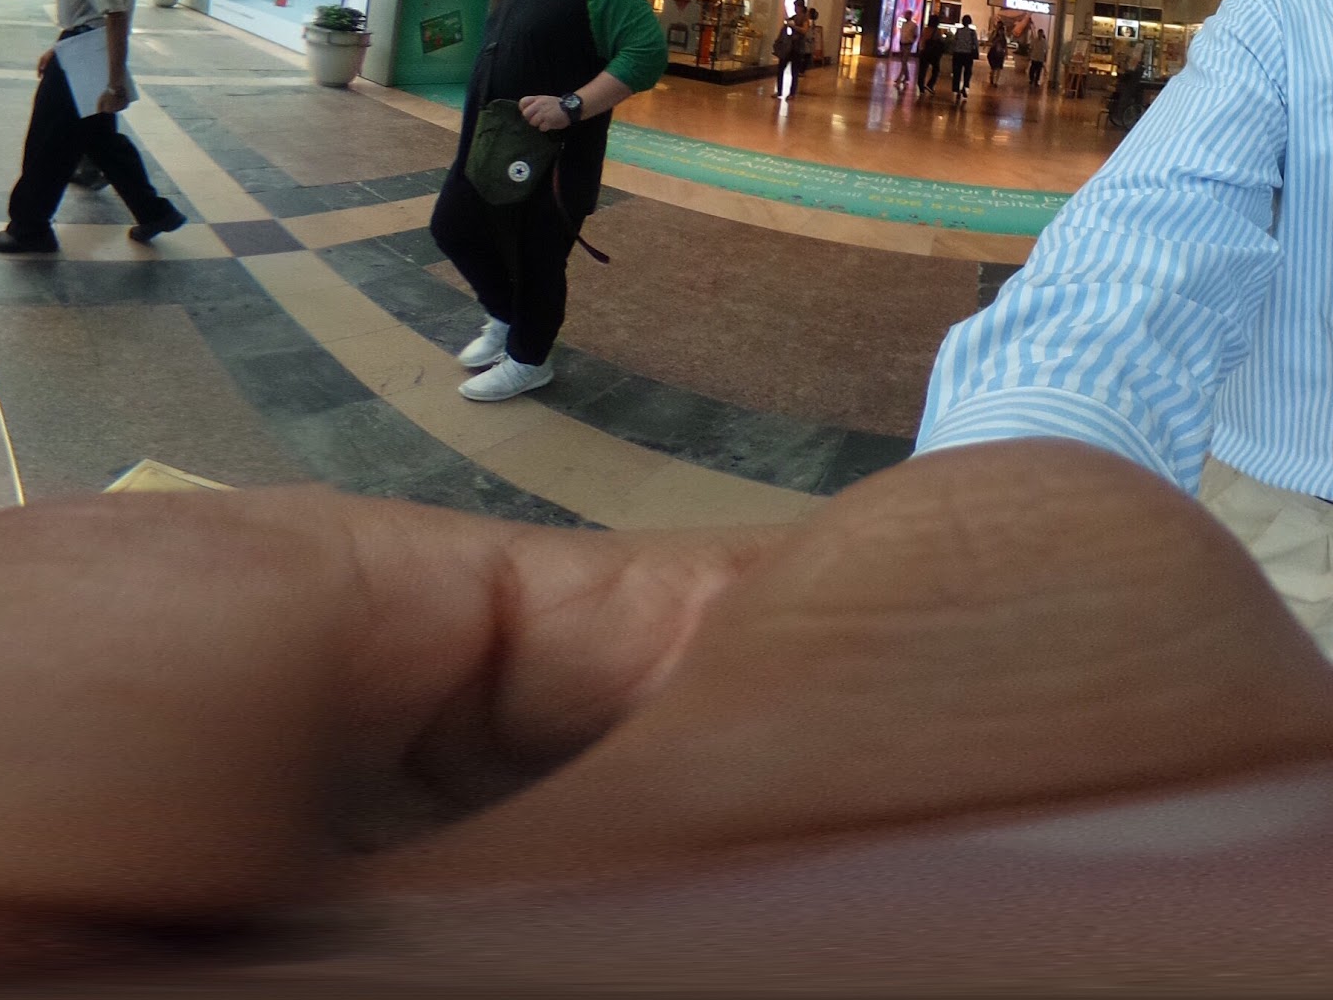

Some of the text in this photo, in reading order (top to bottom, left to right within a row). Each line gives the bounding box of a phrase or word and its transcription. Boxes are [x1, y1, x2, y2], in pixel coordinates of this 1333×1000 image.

[735, 161, 845, 185] American
[854, 181, 944, 199] Express
[754, 156, 848, 179] shopping
[856, 173, 899, 186] with
[909, 181, 983, 196] 3-hour
[992, 189, 1035, 201] free
